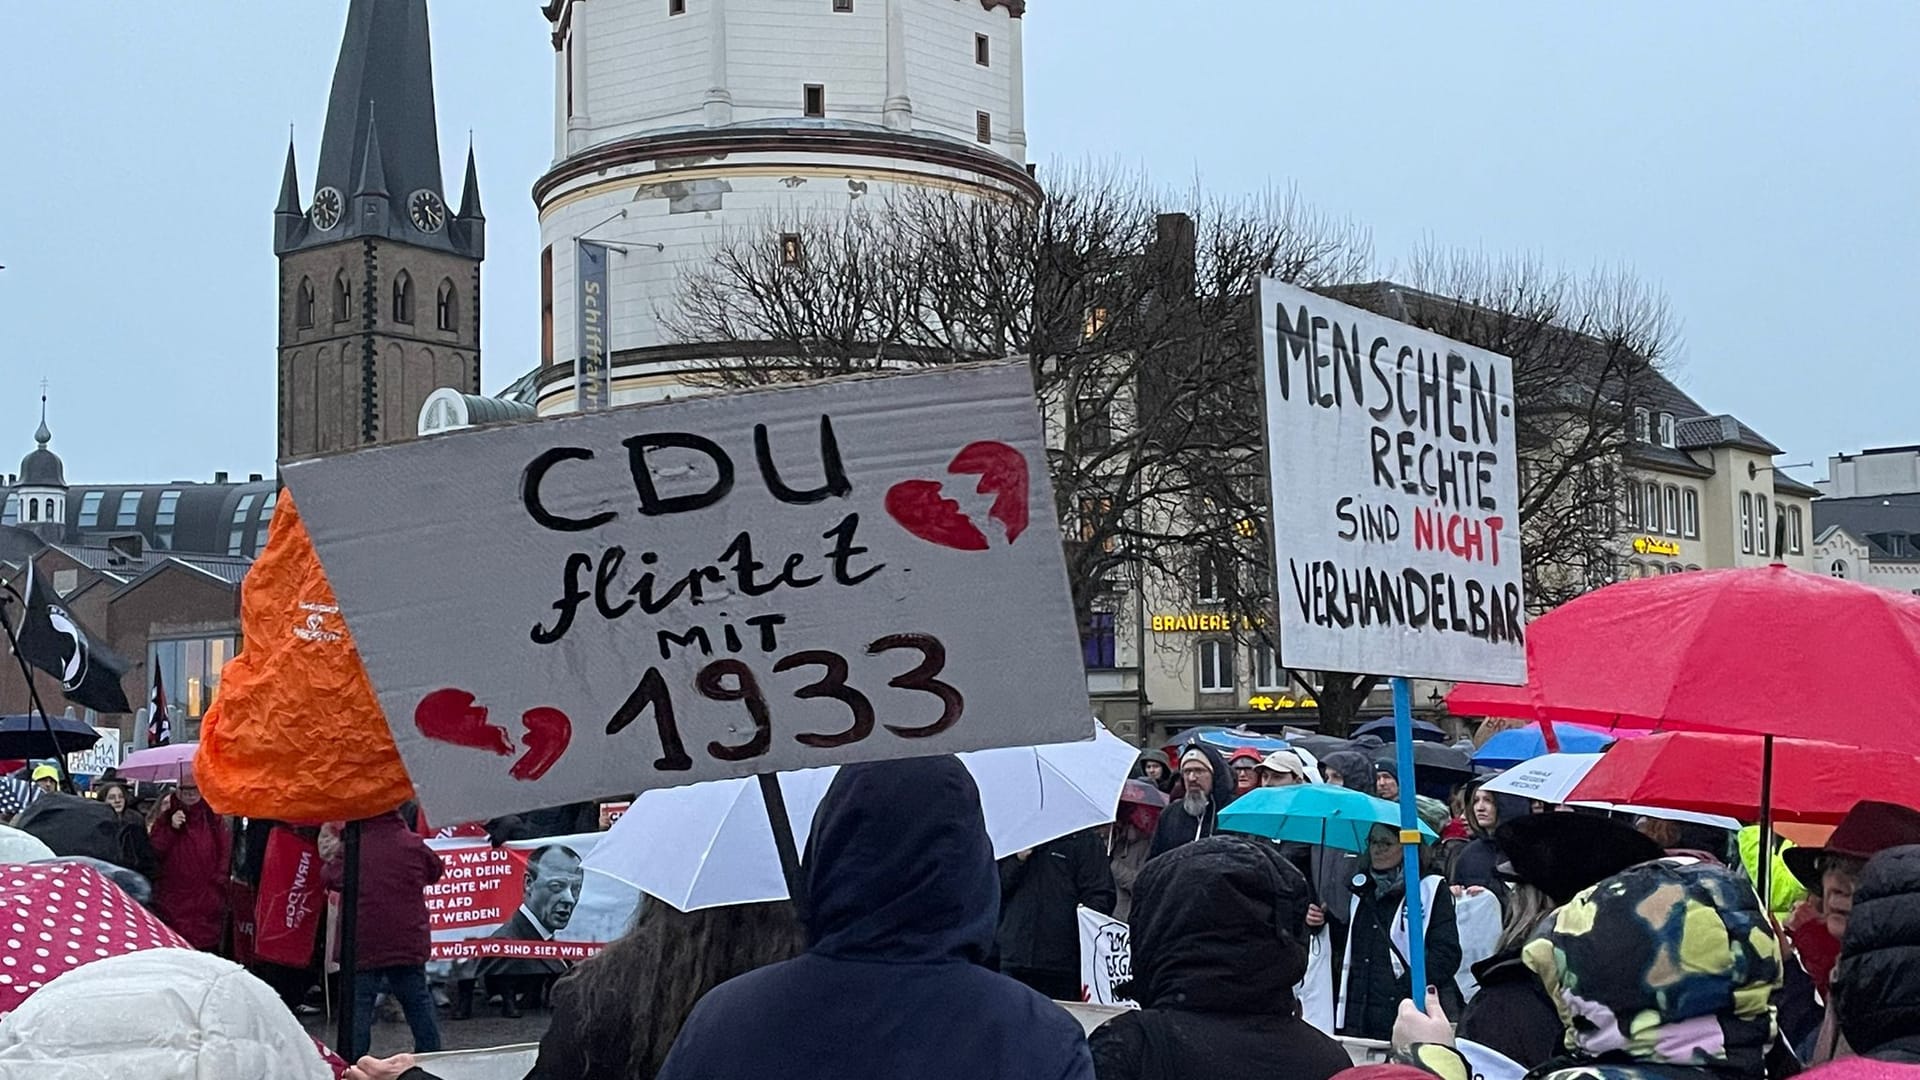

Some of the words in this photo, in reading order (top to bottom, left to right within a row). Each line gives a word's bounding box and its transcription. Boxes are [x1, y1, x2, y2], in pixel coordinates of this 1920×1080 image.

[519, 414, 853, 532] CDU
[1371, 426, 1498, 512] RECHTE
[530, 512, 887, 644] flirtet
[1289, 558, 1524, 645] VERHANDELBAR
[606, 633, 964, 771] 1933
[440, 868, 472, 881] VOR
[475, 865, 512, 876] DEINE
[459, 851, 487, 864] WAS
[490, 850, 508, 861] DU
[423, 881, 476, 896] RECHTE
[479, 879, 501, 890] MIT
[425, 898, 445, 910] ER
[448, 896, 473, 908] AFD
[442, 943, 478, 957] WÜST,
[481, 943, 500, 955] WO
[504, 944, 531, 956] SIND
[534, 945, 557, 956] SIE?
[560, 945, 584, 957] WIR
